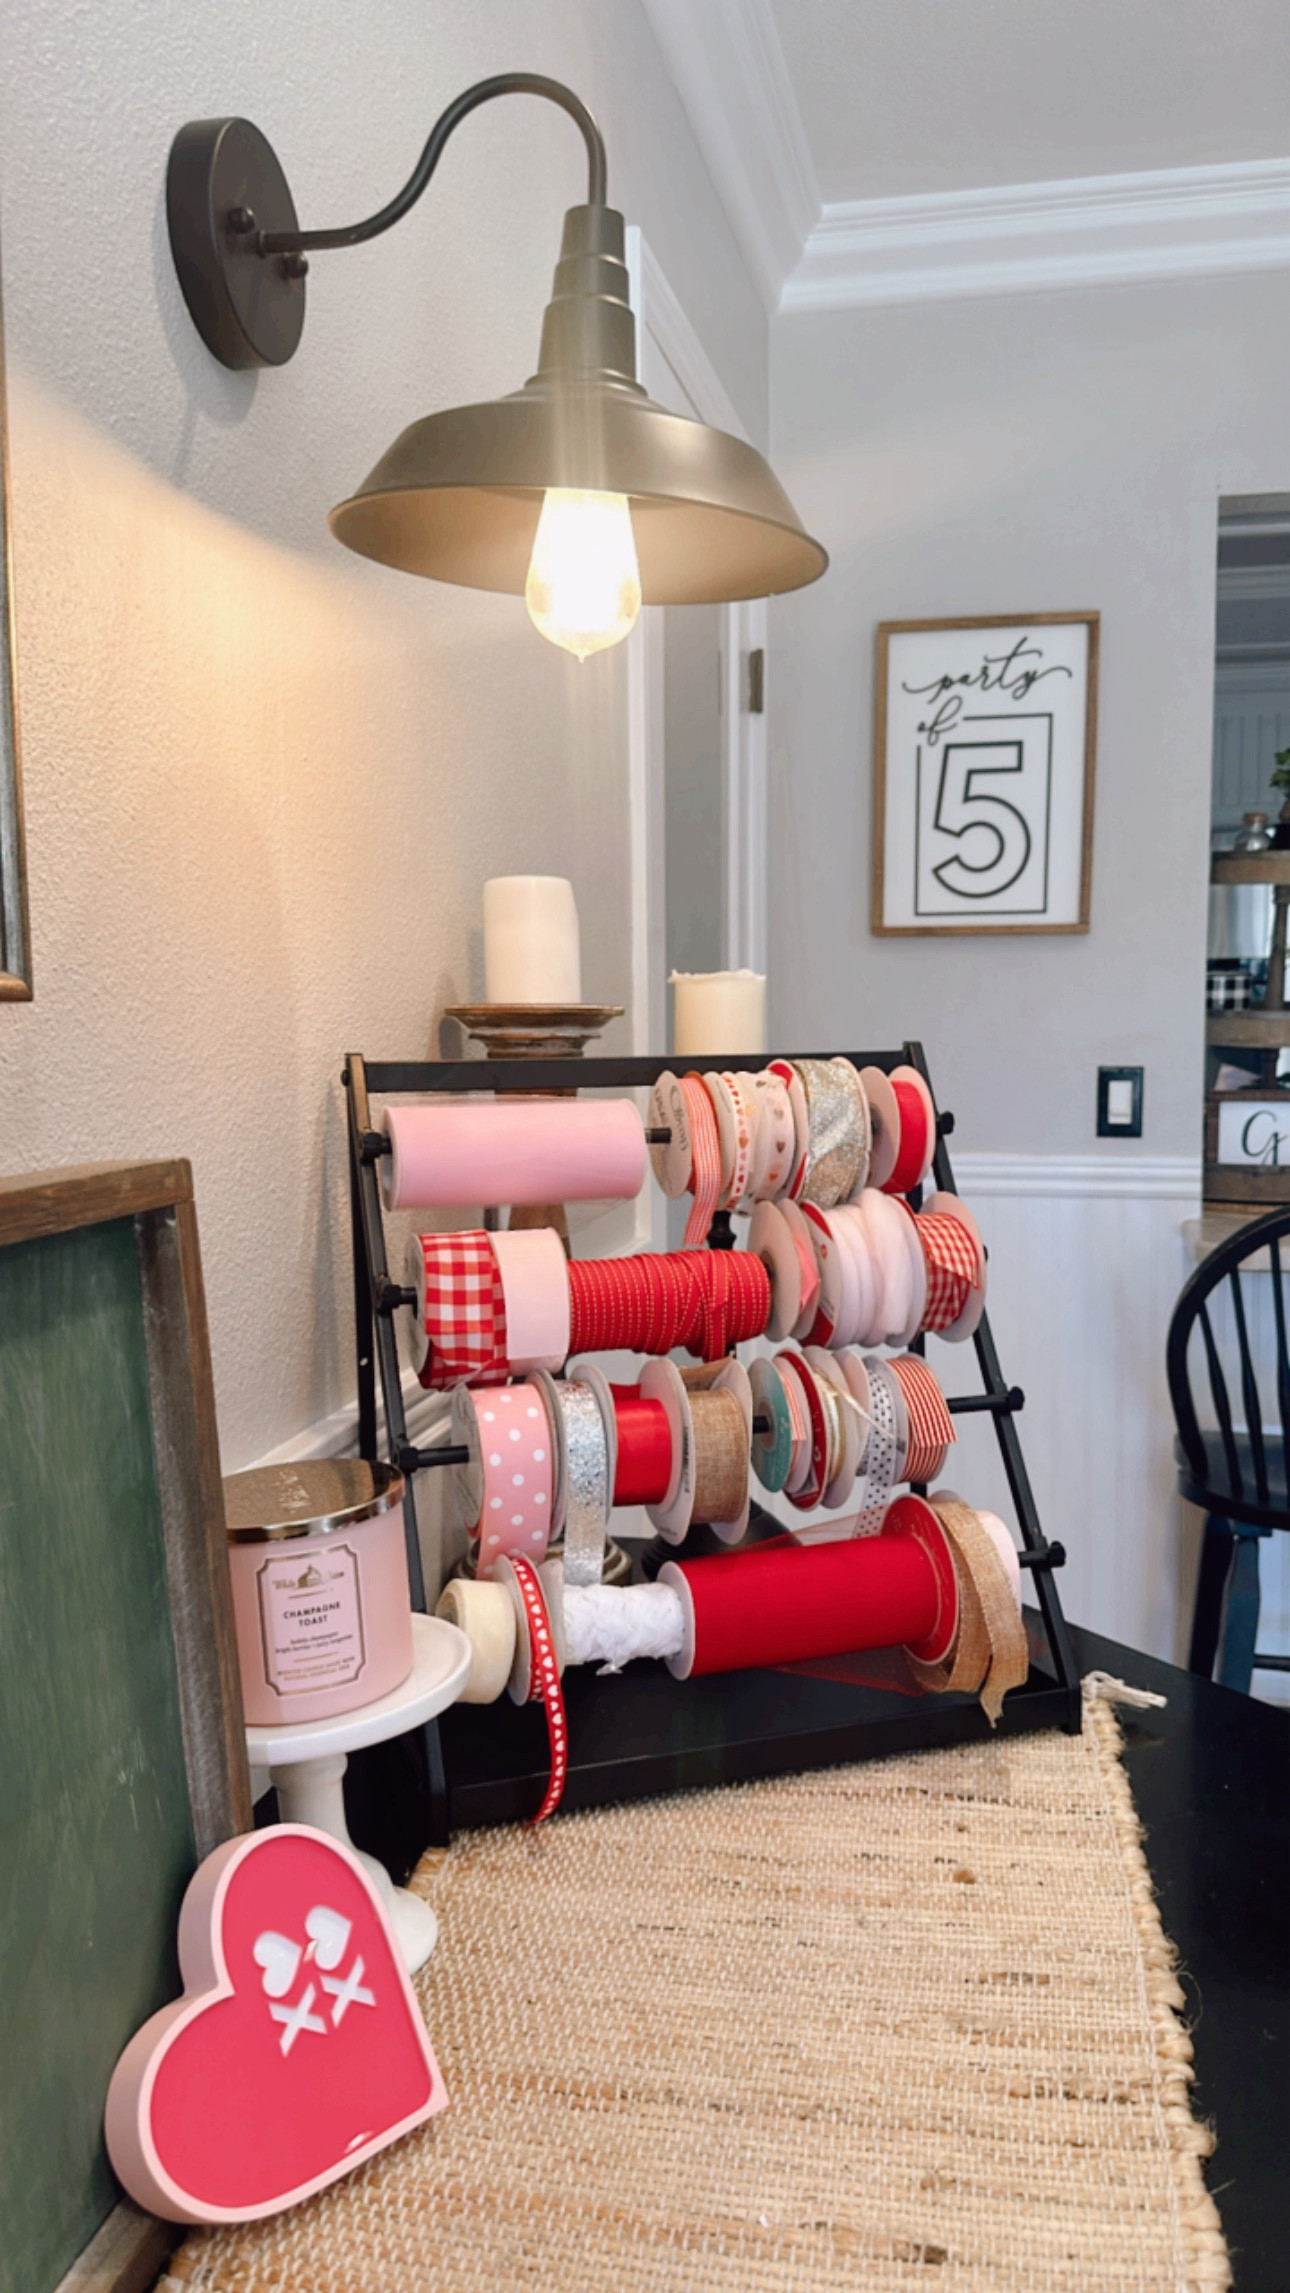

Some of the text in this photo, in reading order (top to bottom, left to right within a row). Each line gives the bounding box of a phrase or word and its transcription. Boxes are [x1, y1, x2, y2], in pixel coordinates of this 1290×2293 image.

[902, 636, 1072, 704] party
[917, 695, 963, 747] of
[932, 740, 1031, 898] 5
[283, 1601, 341, 1619] CHAMPAGNE
[298, 1614, 328, 1627] TOAST
